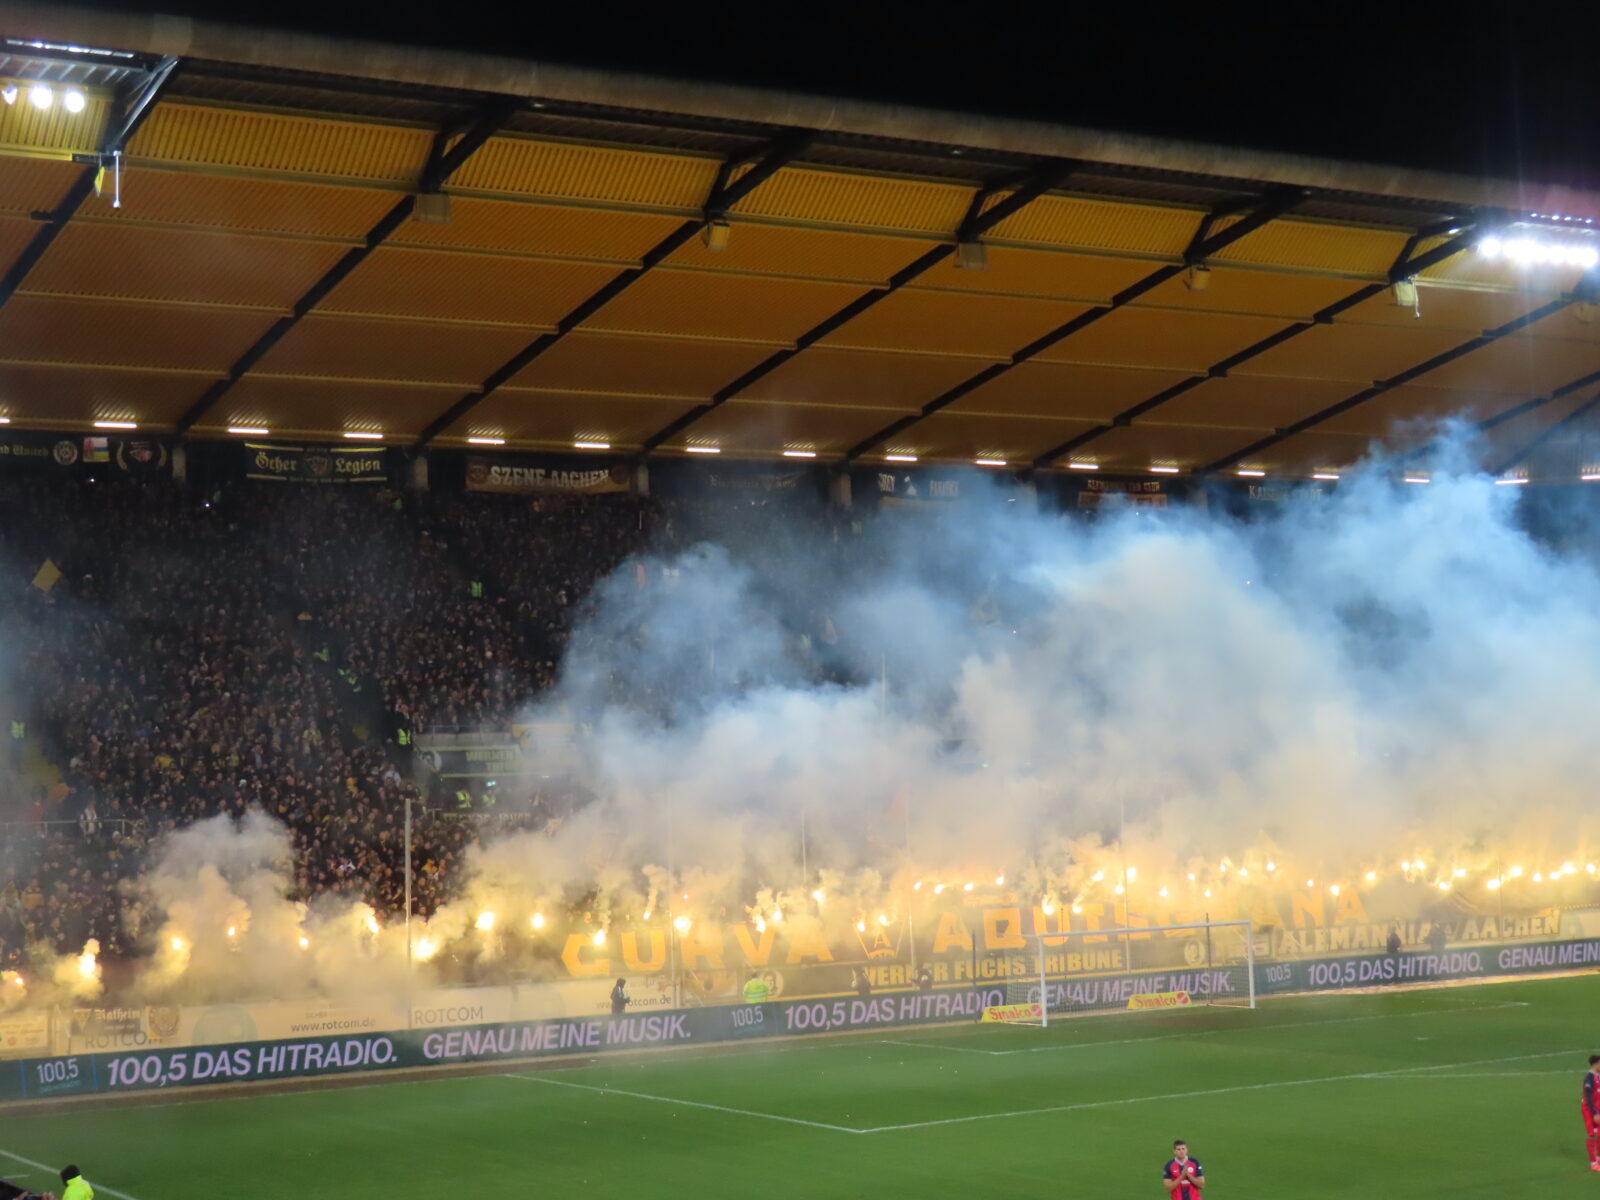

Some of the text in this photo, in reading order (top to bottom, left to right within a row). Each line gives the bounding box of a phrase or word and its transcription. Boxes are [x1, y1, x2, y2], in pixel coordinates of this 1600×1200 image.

[255, 451, 381, 475] Öcher Legion
[490, 465, 610, 488] SZENE AACHEN
[1462, 909, 1561, 940] AACHEN
[561, 920, 835, 978] CURVA
[1499, 942, 1600, 969] GENAU MEIN
[954, 957, 1027, 981] FUCHS
[1308, 961, 1358, 988] 100,5
[1359, 957, 1395, 983] DAS
[1398, 951, 1483, 979] HITRADIO.
[1102, 976, 1166, 1002] MEINE
[1169, 971, 1236, 996] MUSIK.
[785, 1001, 847, 1031] 100,5
[850, 998, 895, 1024] DAS
[989, 1006, 1032, 1020] Sinalco
[1135, 993, 1177, 1009] Sinalco
[290, 1016, 377, 1033] www.rotcom.de
[414, 1005, 484, 1025] ROTCOM
[423, 1014, 692, 1060] GENAU MEINE MUSIK.
[107, 1053, 188, 1087] 100,5
[192, 1048, 252, 1079] DAS
[256, 1037, 398, 1074] HITRADIO.
